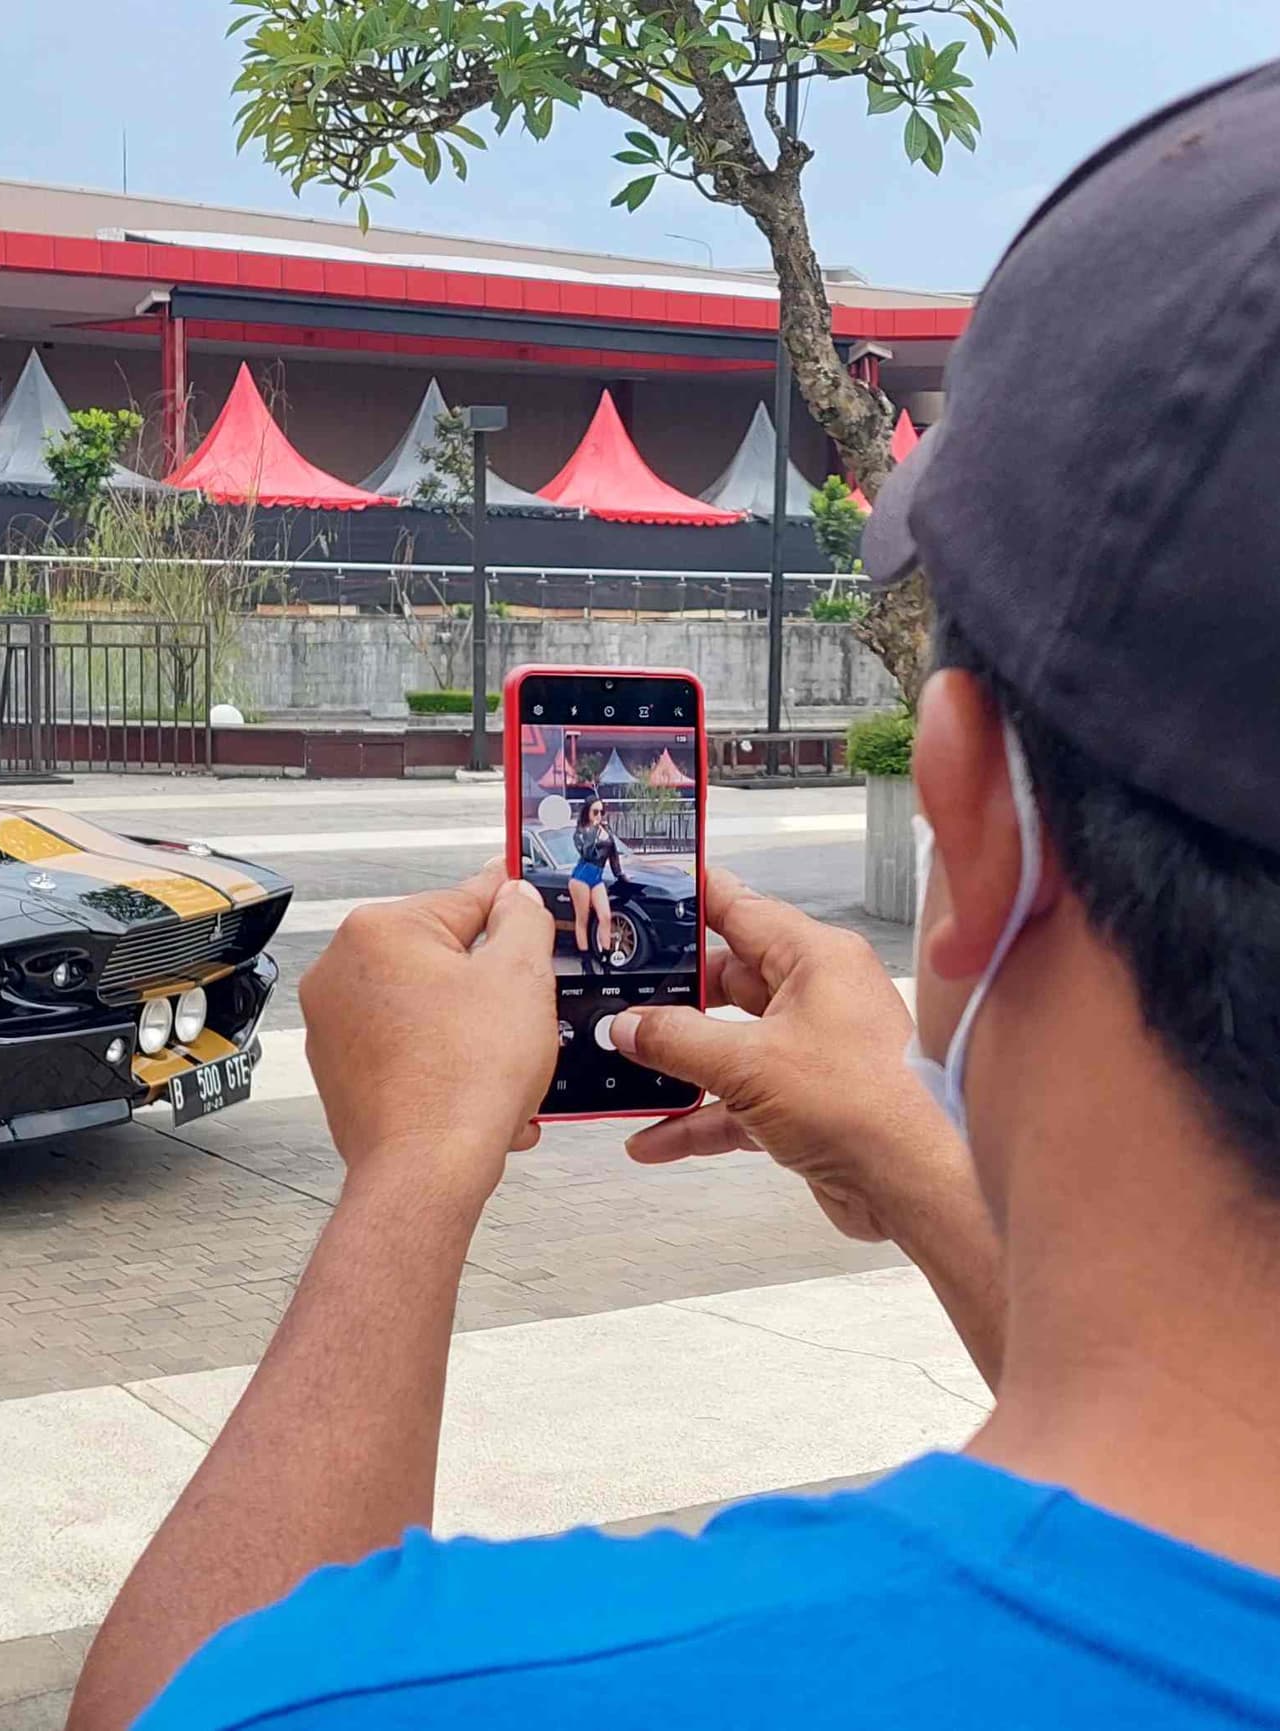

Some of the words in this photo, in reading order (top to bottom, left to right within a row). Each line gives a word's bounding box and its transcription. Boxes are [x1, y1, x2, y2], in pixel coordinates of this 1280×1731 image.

[602, 986, 621, 996] FOTO
[172, 1077, 185, 1110] B
[196, 1063, 222, 1101] 500
